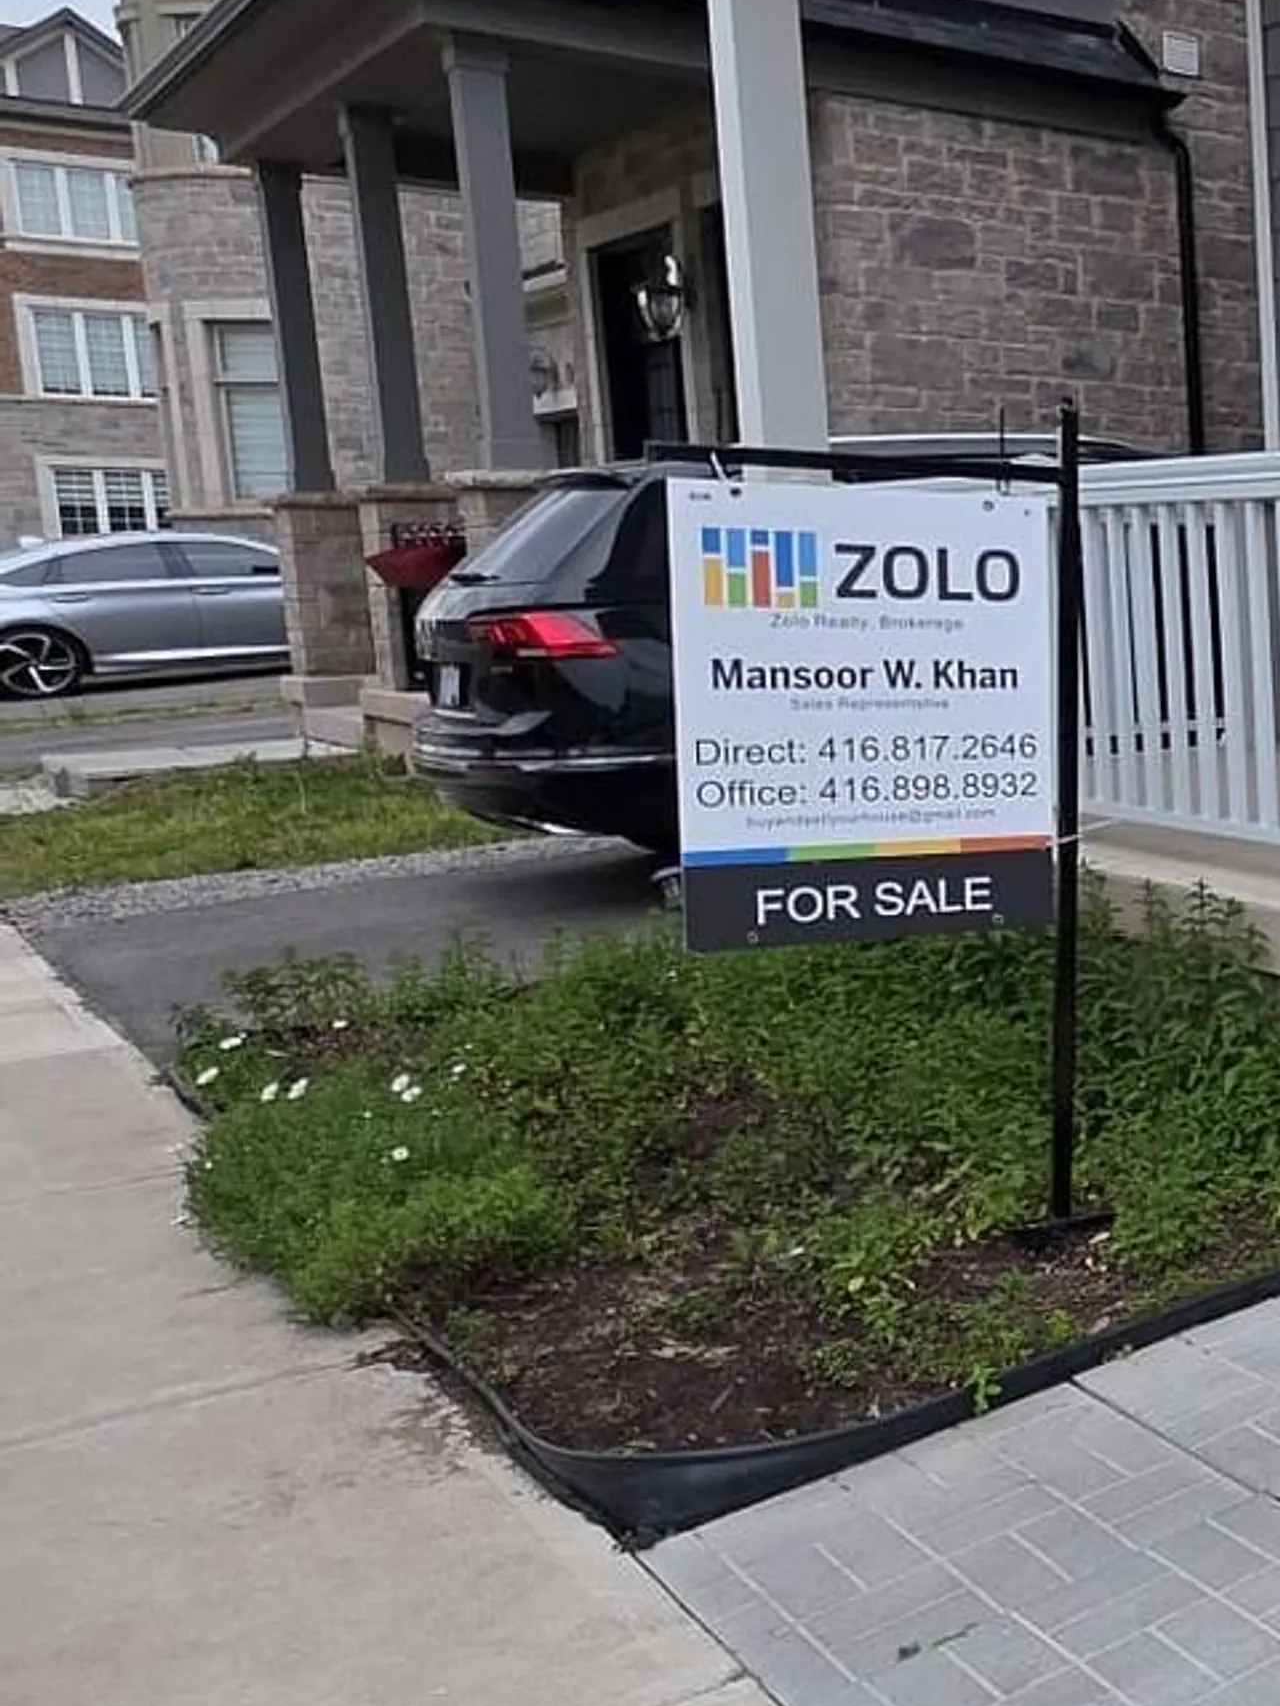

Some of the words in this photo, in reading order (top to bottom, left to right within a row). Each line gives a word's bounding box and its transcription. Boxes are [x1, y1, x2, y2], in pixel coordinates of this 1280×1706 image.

[834, 542, 1021, 602] ZOLO
[711, 657, 875, 691] Mansoor
[883, 659, 922, 691] W.
[934, 658, 1019, 691] Khan
[694, 736, 807, 768] Direct:
[818, 733, 1038, 763] 416.817.2646
[696, 778, 807, 809] Office:
[818, 772, 1038, 805] 416.898.8932
[755, 885, 861, 926] FOR
[874, 876, 993, 917] SALE
